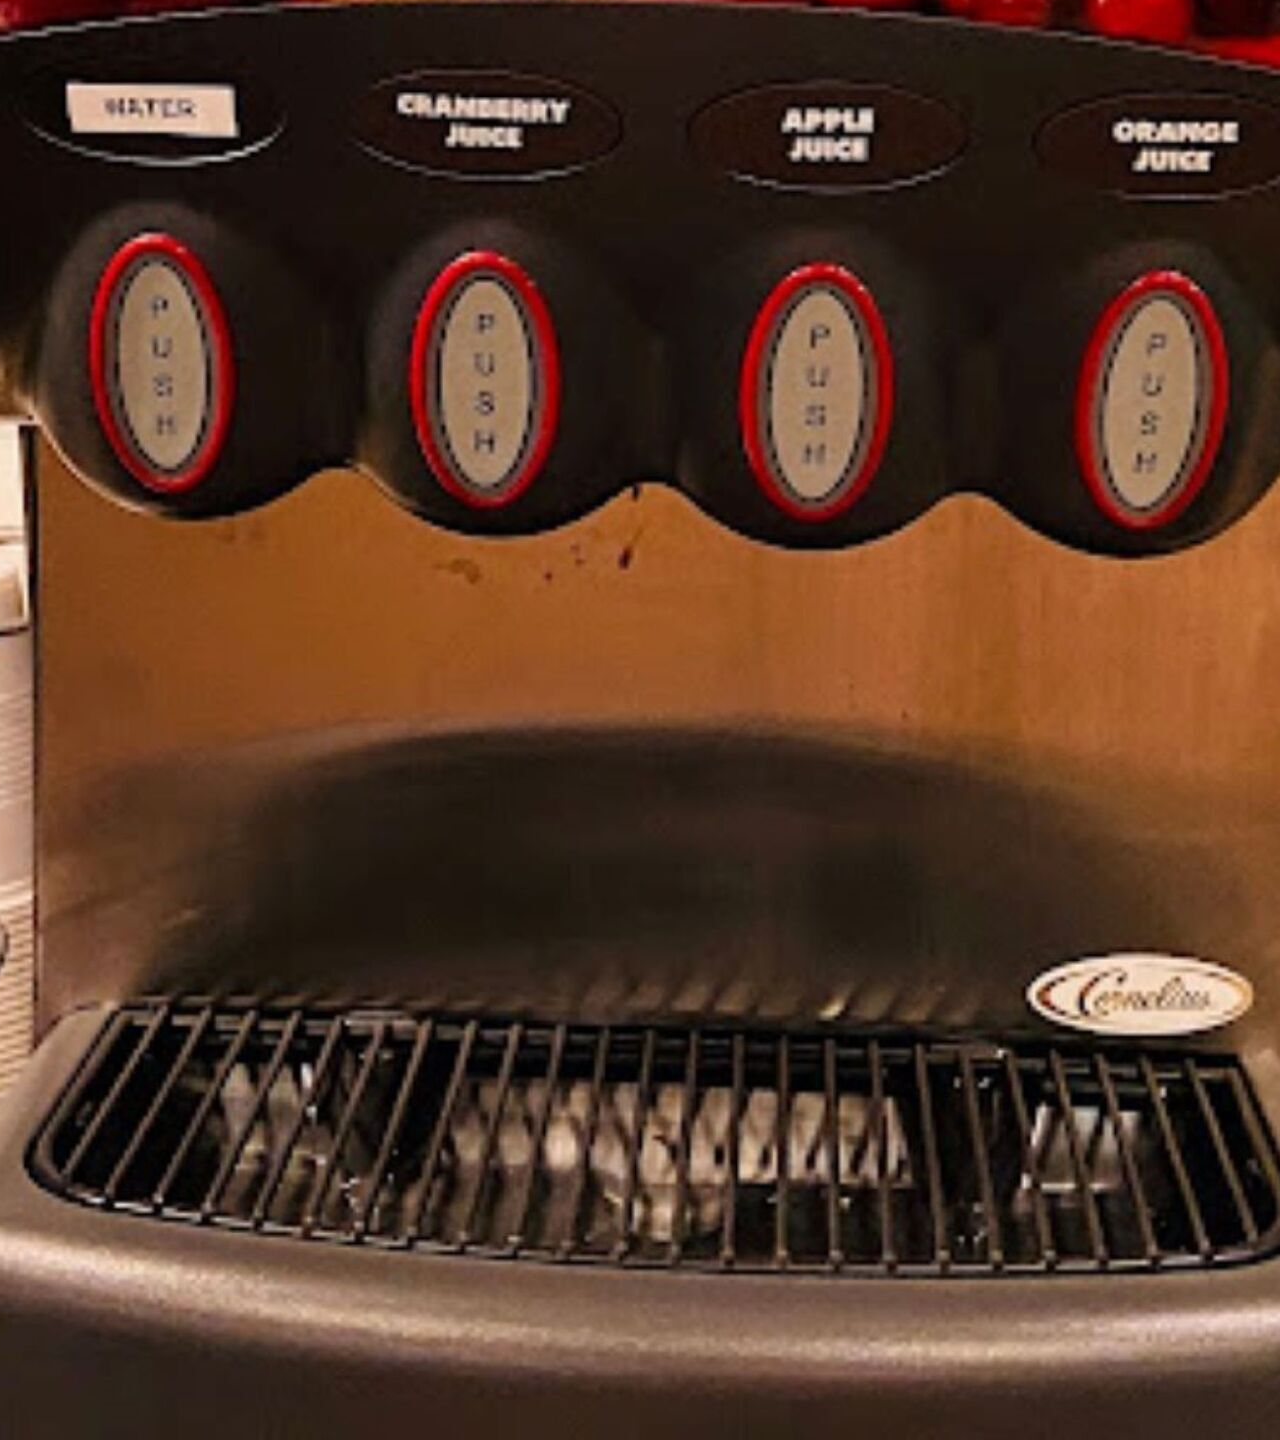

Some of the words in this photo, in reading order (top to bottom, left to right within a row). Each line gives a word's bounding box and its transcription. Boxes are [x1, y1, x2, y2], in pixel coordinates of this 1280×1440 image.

[103, 97, 197, 119] WATER
[397, 93, 570, 124] CRANBERRY
[781, 108, 874, 133] APPLE
[445, 122, 524, 148] JUICE
[1112, 120, 1238, 142] ORANGE
[786, 136, 869, 162] JUICE
[1131, 149, 1214, 171] JUICE
[151, 295, 176, 437] PUSH
[473, 313, 496, 454] PUSH
[803, 324, 831, 466] PUSH
[1132, 333, 1166, 475] PUSH
[1077, 966, 1211, 1016] Cornelius
